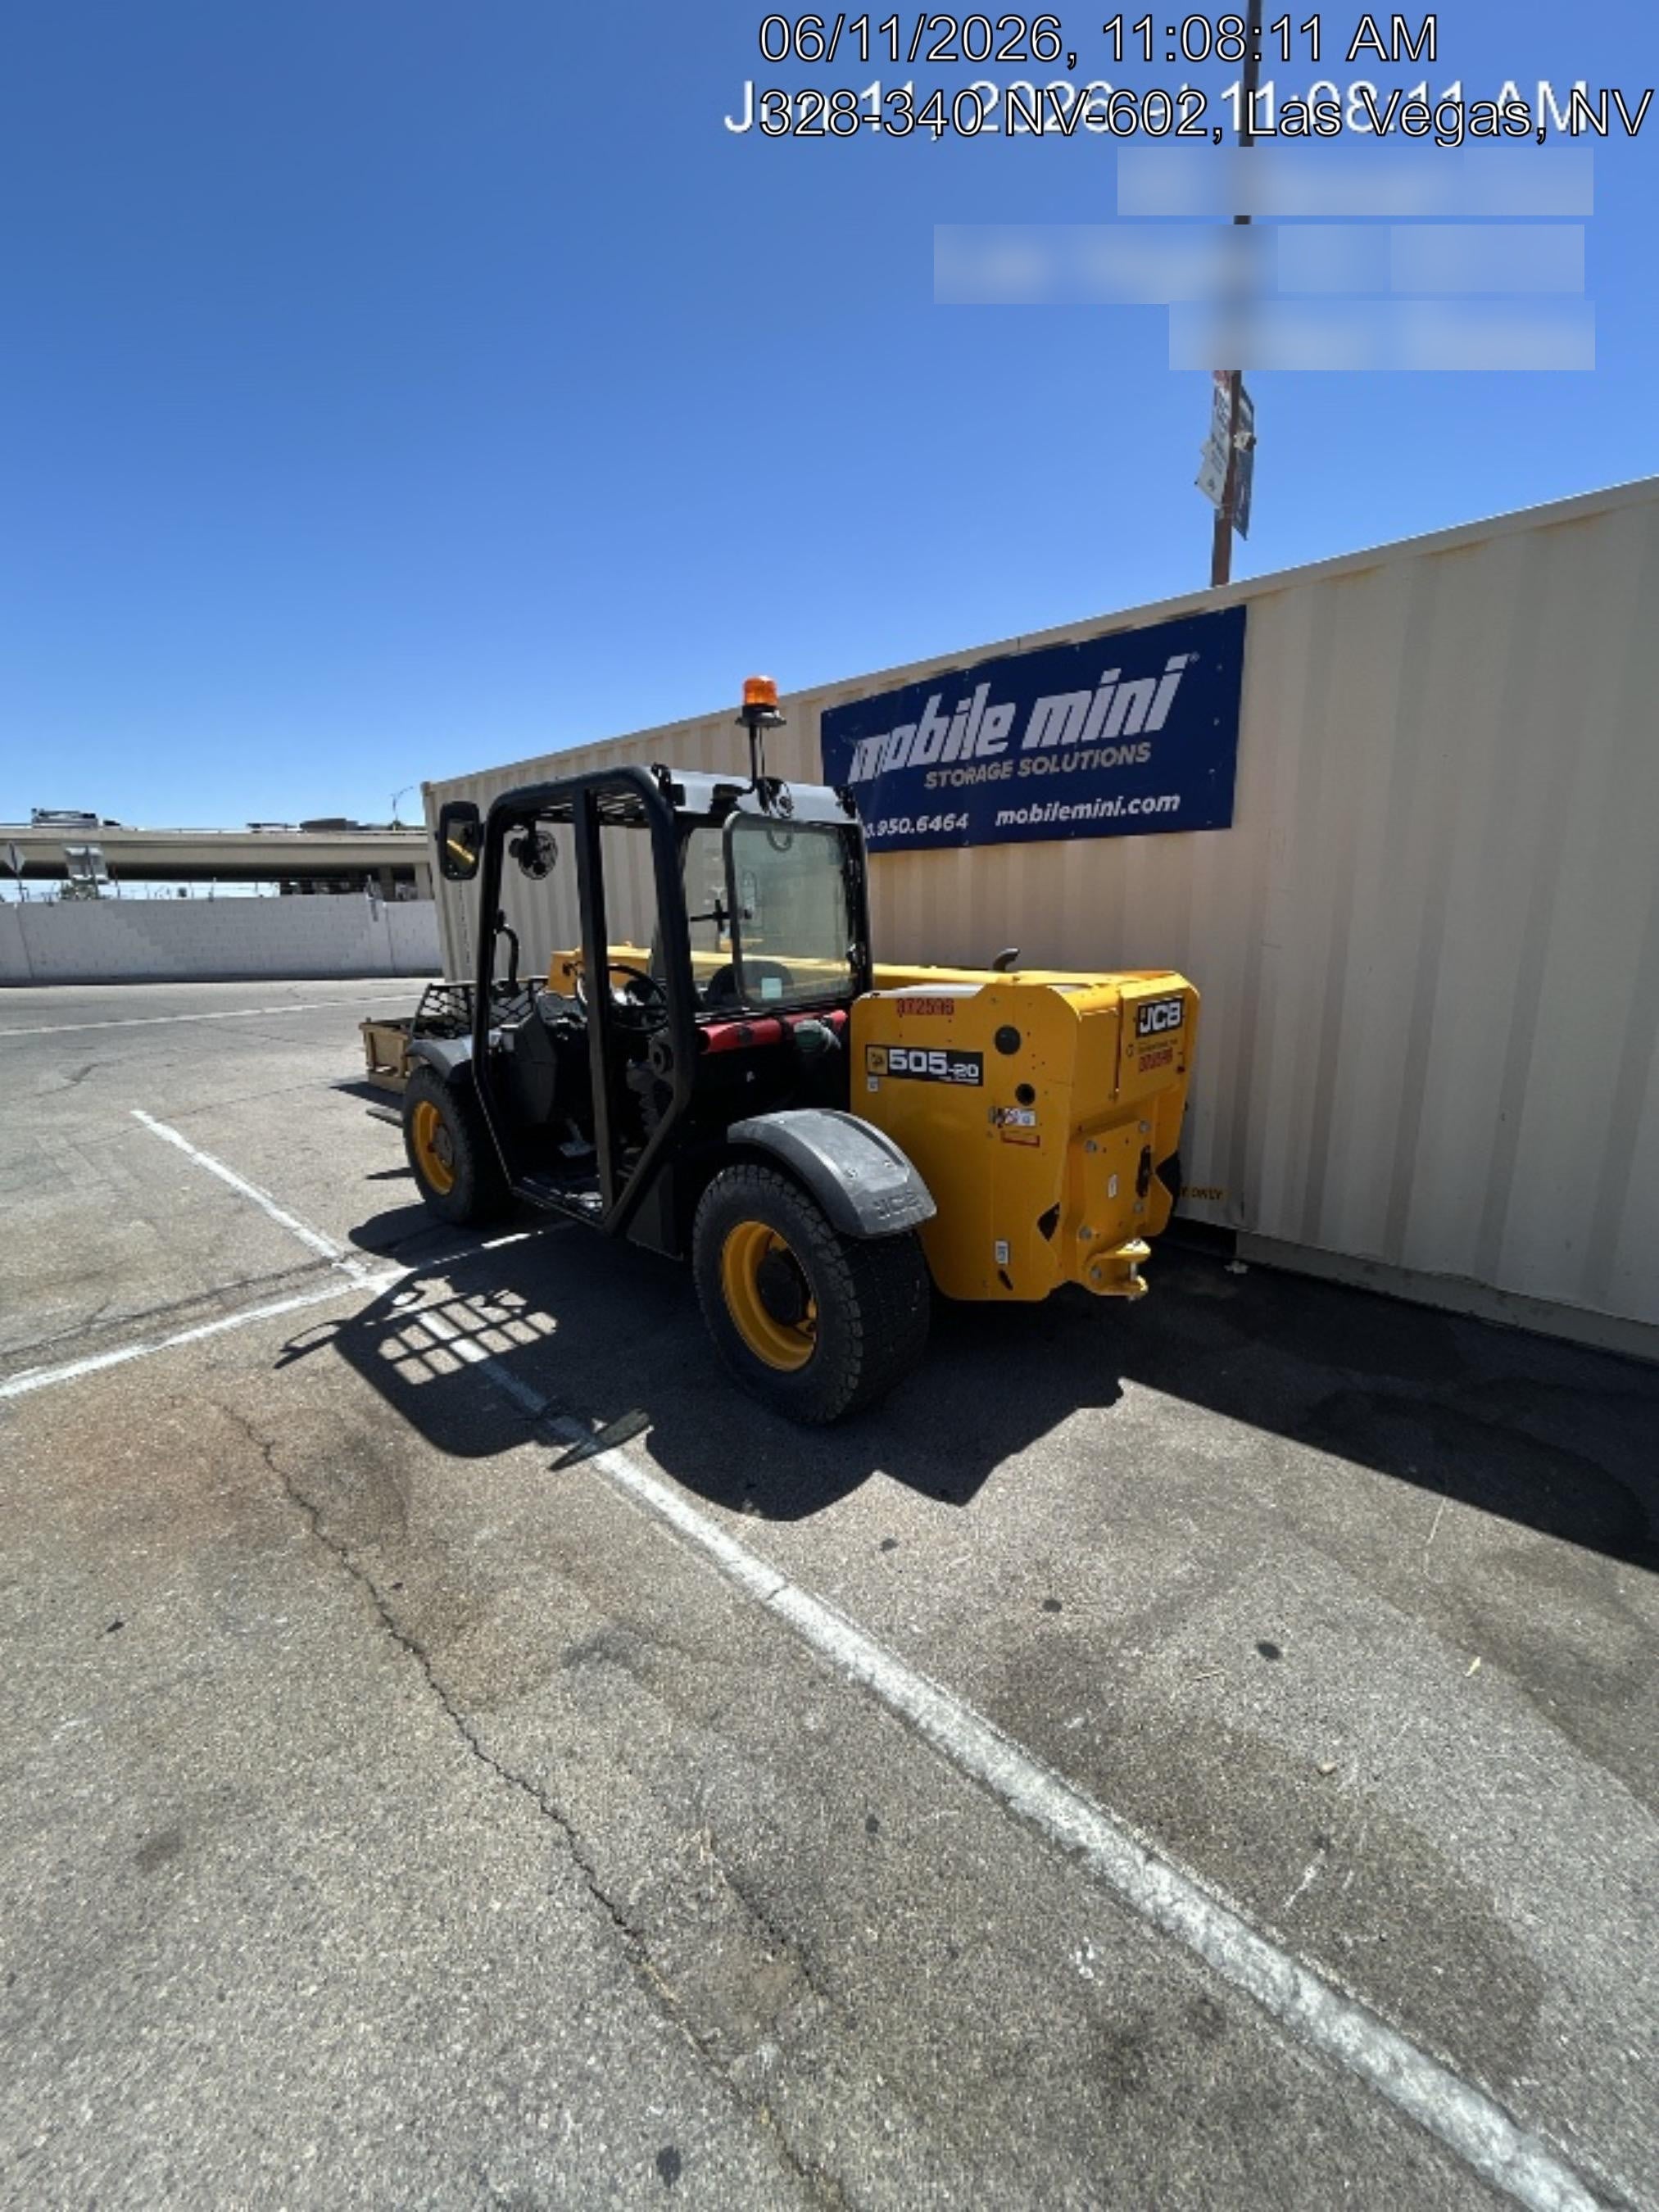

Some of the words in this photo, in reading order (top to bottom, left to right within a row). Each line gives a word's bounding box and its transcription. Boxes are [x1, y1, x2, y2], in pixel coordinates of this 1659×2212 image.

[847, 682, 1017, 785] mobile
[924, 759, 1014, 790] STORAGE
[1017, 741, 1151, 778] SOLUTIONS
[995, 793, 1181, 827] mobilemini.com
[1140, 1001, 1181, 1034] JCB
